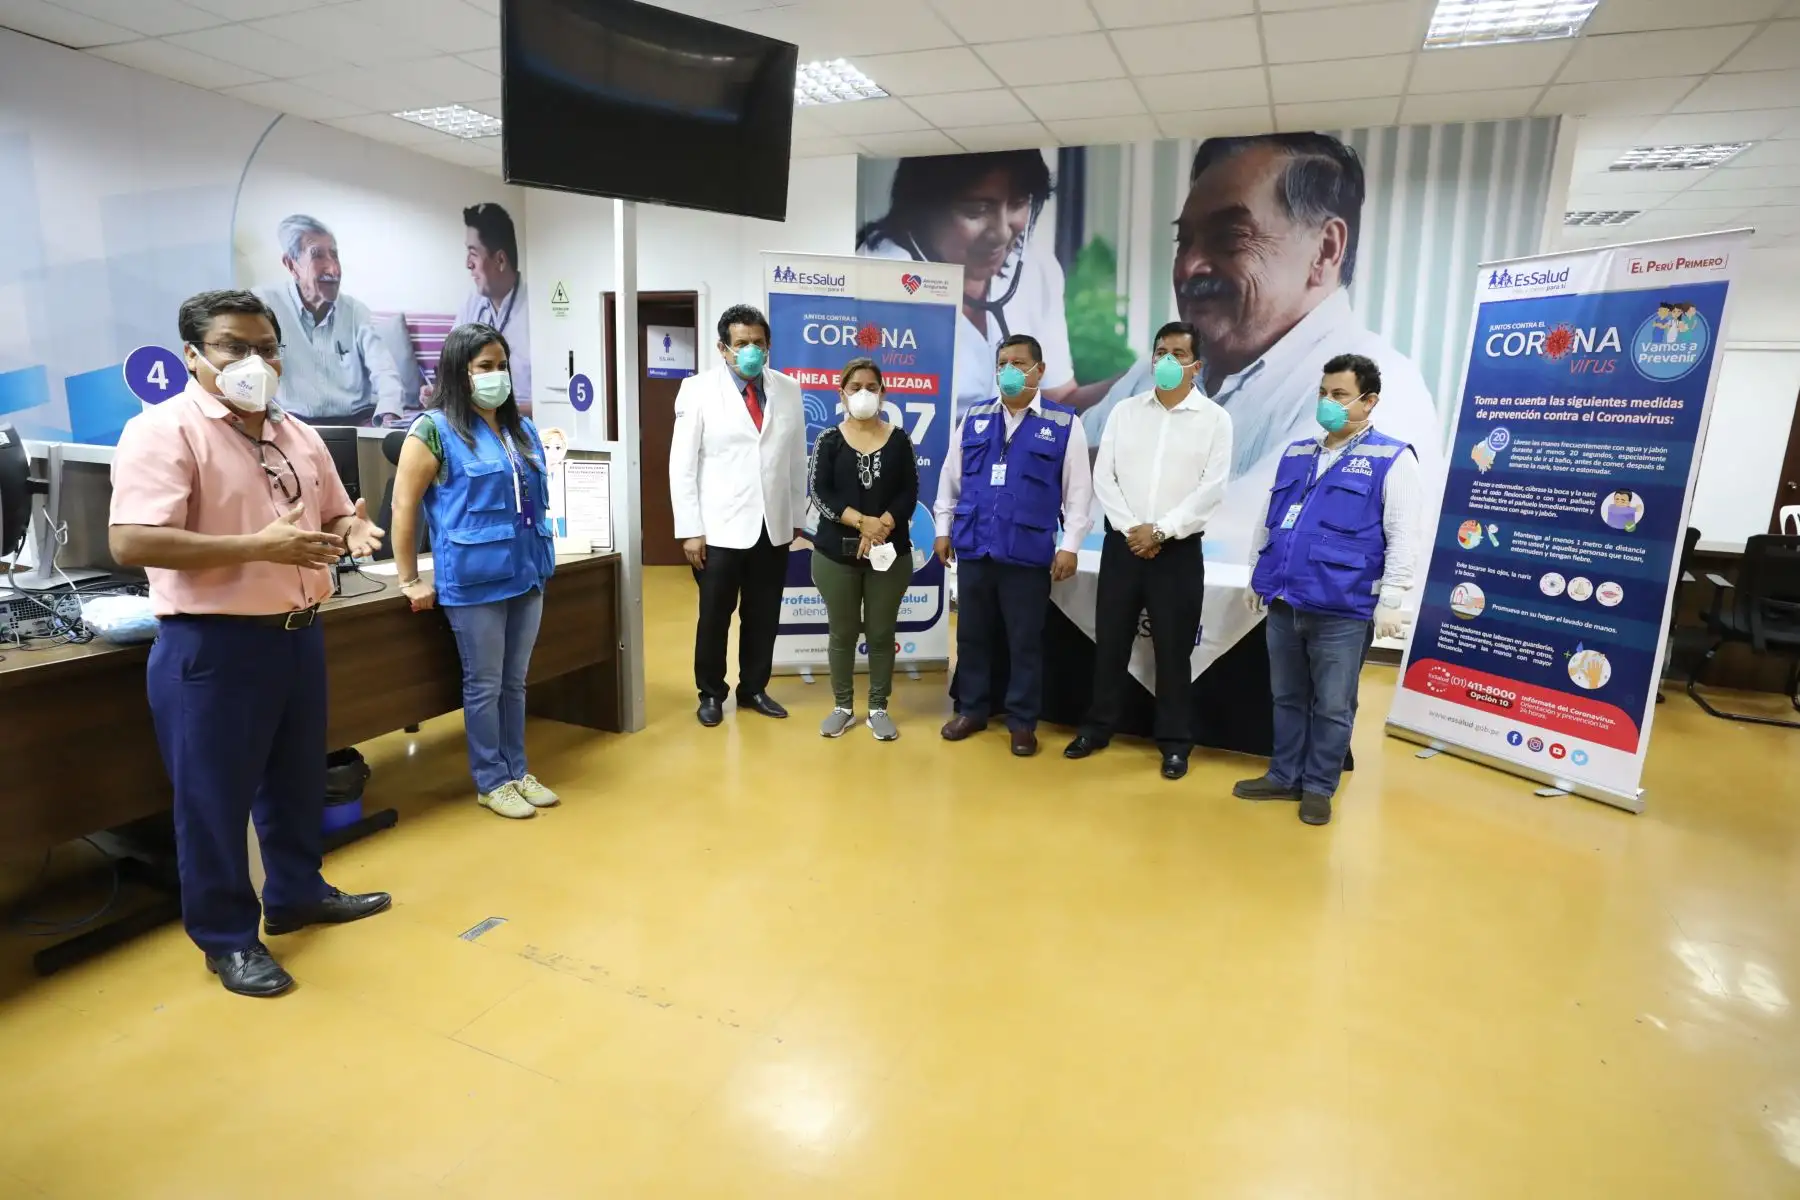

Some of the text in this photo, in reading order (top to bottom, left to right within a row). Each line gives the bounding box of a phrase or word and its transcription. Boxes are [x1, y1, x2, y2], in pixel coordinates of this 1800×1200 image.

[1631, 258, 1722, 274] EL PERÚ PRIMERO
[799, 272, 845, 287] EsSalud
[1514, 267, 1570, 287] EsSalud
[1488, 324, 1511, 332] JUNTOS
[1512, 322, 1537, 330] CONTRA
[1641, 342, 1698, 352] Vamos a
[882, 352, 916, 366] virus
[1638, 351, 1697, 363] Prevenir
[1569, 356, 1616, 375] virus
[147, 360, 169, 390] 4
[576, 383, 586, 402] 5
[1474, 395, 1684, 408] Toma en cuenta las siguientes medidas
[1476, 409, 1674, 424] de prevención contra el Coronavirus:
[1493, 432, 1506, 441] 20
[1561, 441, 1611, 450] frecuentemente
[1510, 454, 1532, 462] después
[1626, 462, 1655, 470] después
[1618, 454, 1666, 462] especialmente
[1342, 466, 1373, 476] EsSalud
[1538, 502, 1589, 513] inmediatamente
[1570, 498, 1595, 506] pañuelo
[1513, 531, 1542, 541] Mantenga
[1616, 545, 1646, 554] distancia
[1510, 547, 1543, 556] estornuden
[1550, 552, 1571, 560] tengan
[1578, 548, 1607, 557] personas
[1623, 554, 1644, 564] tosan,
[1537, 612, 1555, 622] hogar
[1563, 617, 1583, 627] lavado
[1584, 621, 1593, 629] de
[1594, 624, 1618, 634] manos.
[1493, 633, 1513, 643] laboran
[1493, 650, 1512, 658] manos
[1451, 676, 1467, 688] (01)
[1468, 681, 1516, 700] 411-8000
[1470, 691, 1497, 704] Opción
[1520, 702, 1556, 714] Orientación
[1561, 713, 1599, 727] prevención
[1521, 695, 1616, 725] Infórmate del Coronavirus.
[1429, 710, 1499, 736] www.essalud.gob.pe
